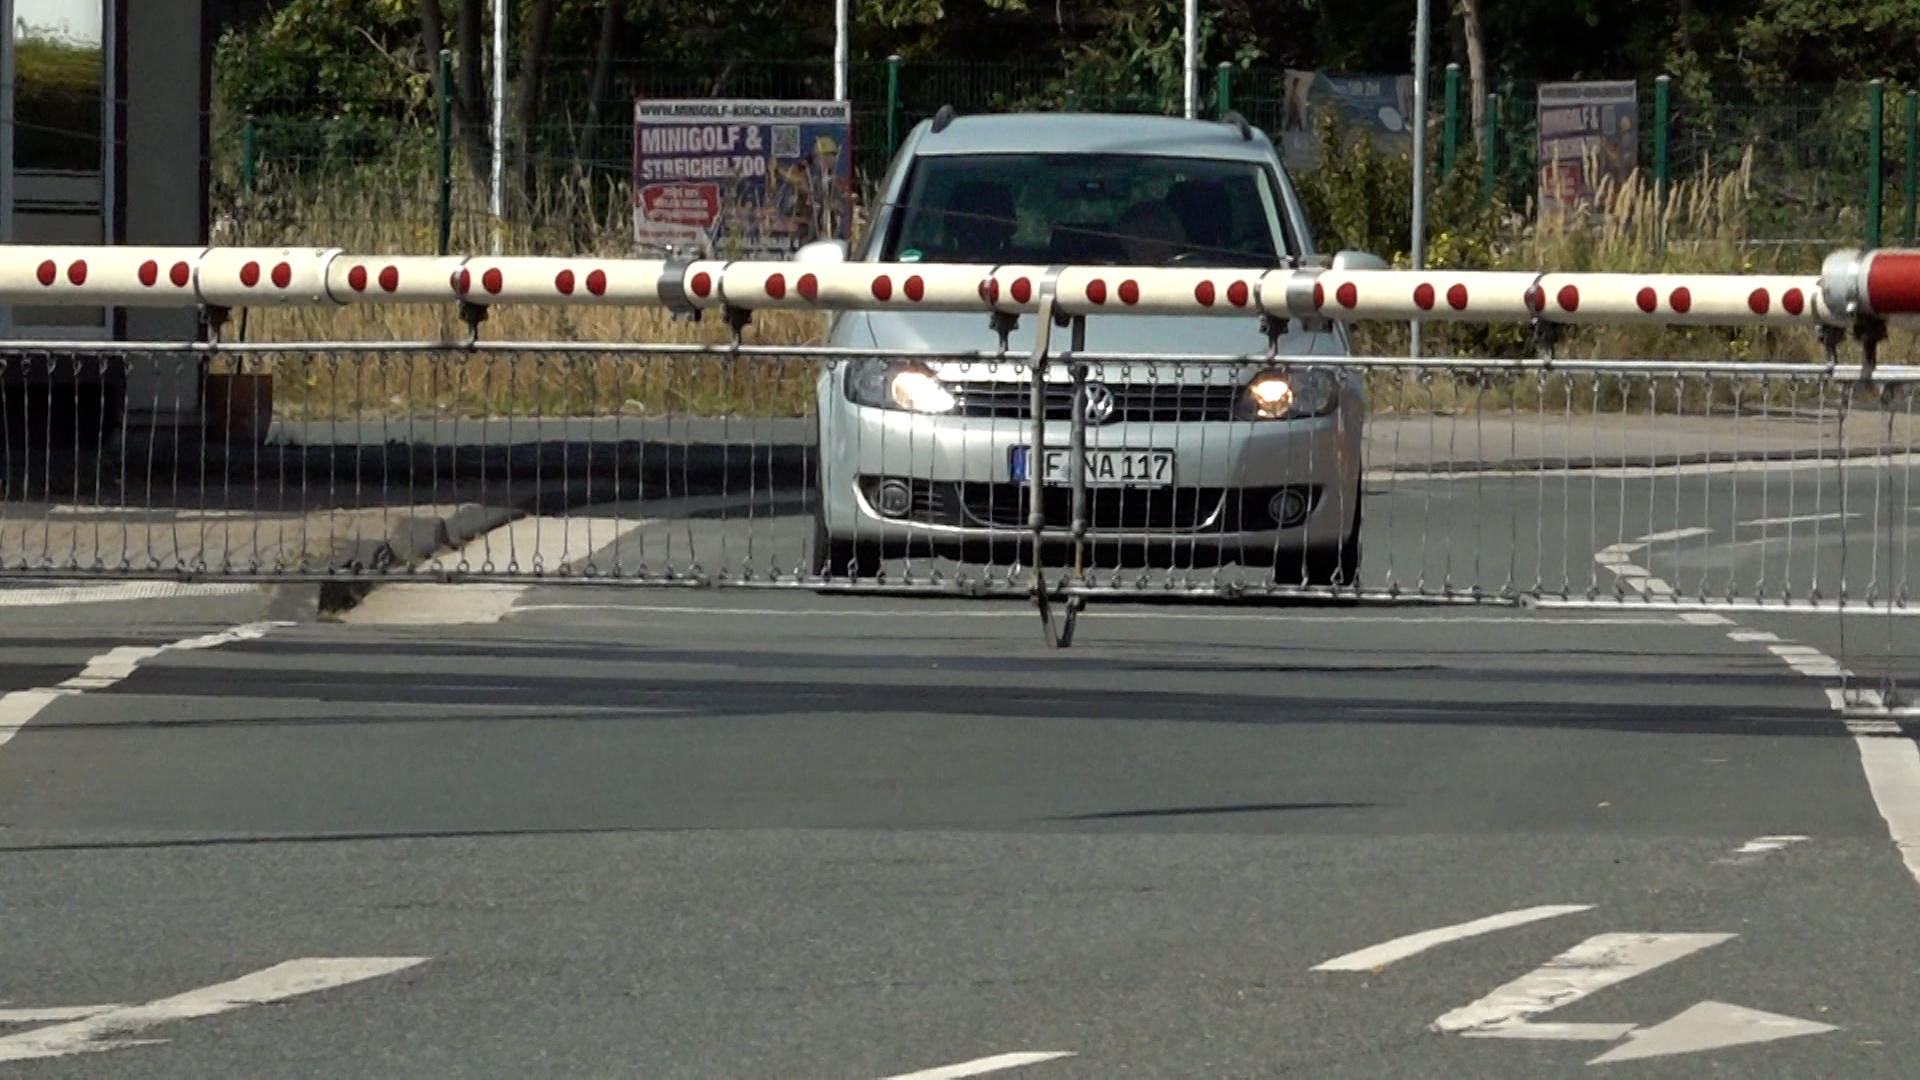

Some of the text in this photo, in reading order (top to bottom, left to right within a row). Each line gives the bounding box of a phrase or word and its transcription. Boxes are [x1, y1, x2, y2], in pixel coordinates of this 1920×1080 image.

[641, 125, 762, 154] MINIGOLF &
[1084, 454, 1115, 480] NA
[1121, 455, 1169, 480] 117
